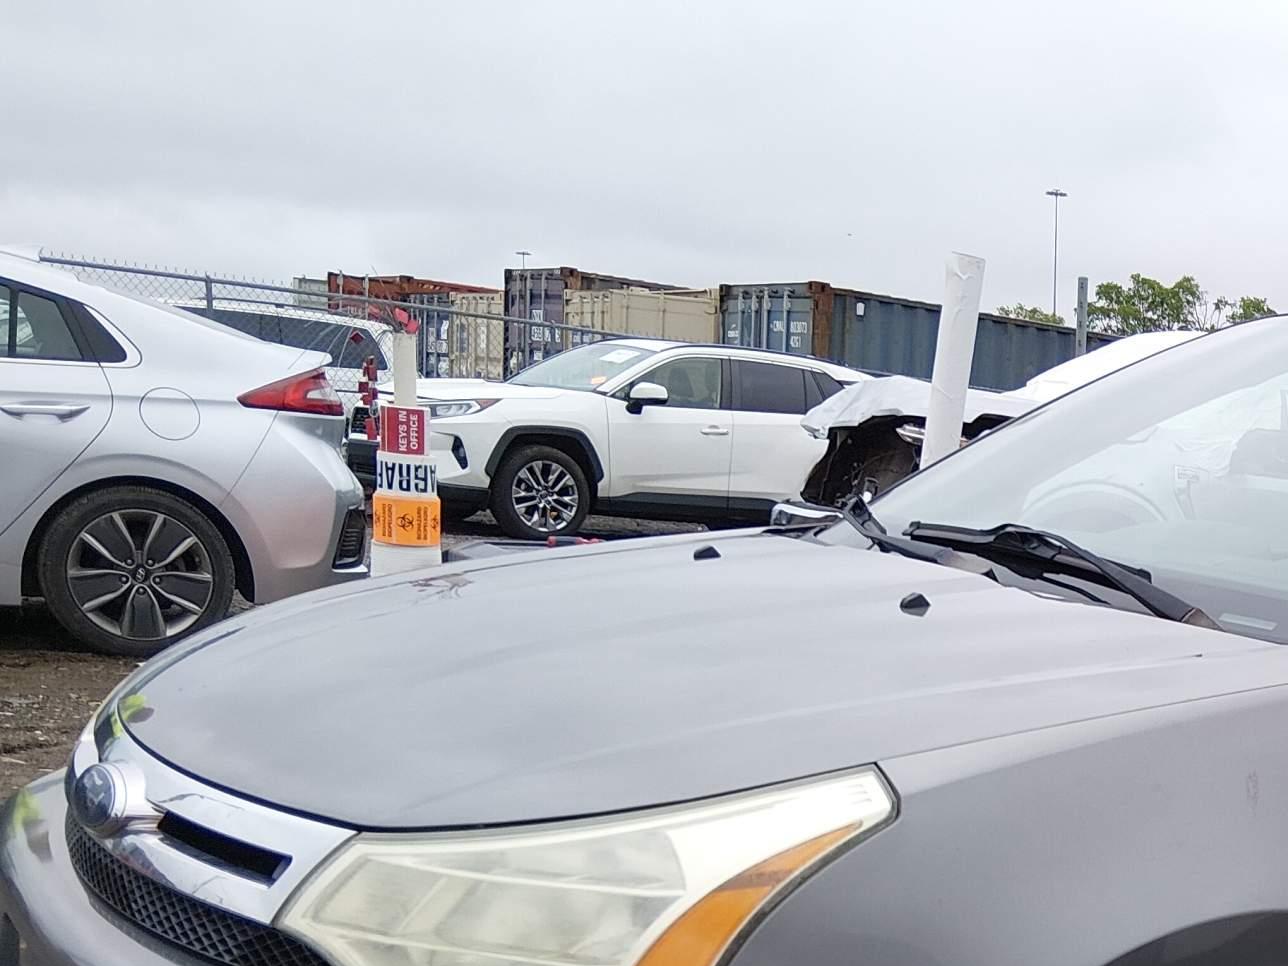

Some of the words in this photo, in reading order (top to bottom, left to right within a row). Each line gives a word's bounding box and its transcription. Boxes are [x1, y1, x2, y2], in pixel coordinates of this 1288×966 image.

[398, 410, 408, 422] IN
[398, 424, 408, 452] KEYS
[409, 413, 419, 450] OFFICE
